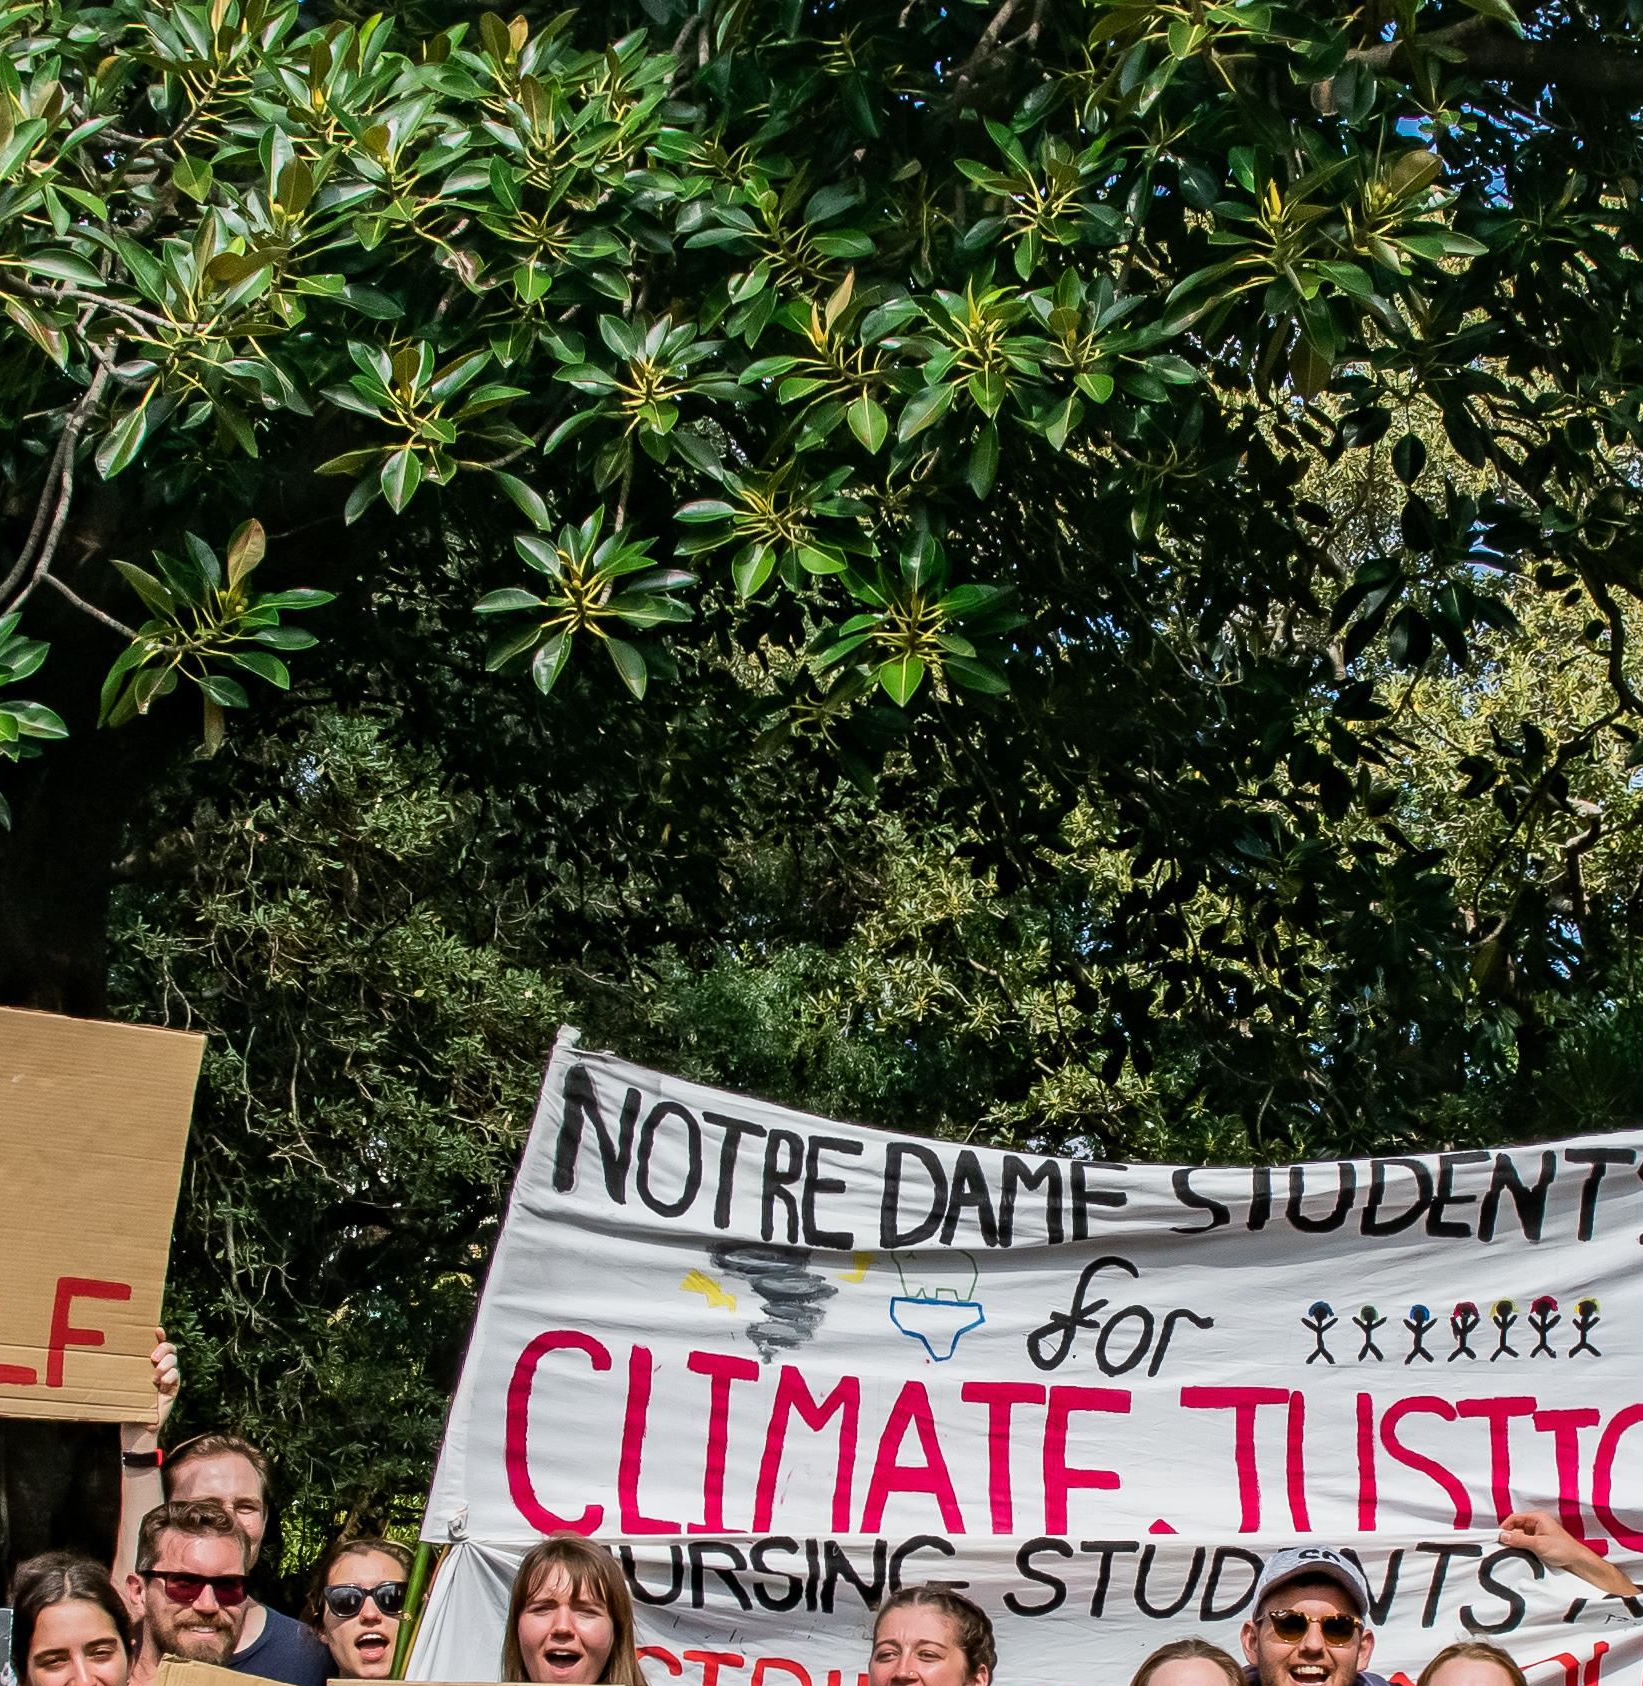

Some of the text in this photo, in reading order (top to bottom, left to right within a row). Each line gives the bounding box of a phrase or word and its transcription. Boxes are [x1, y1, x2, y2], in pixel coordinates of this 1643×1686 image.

[552, 1064, 864, 1250] NOTRE
[1026, 1255, 1215, 1377] for
[1002, 1536, 1545, 1636] STUDNTS
